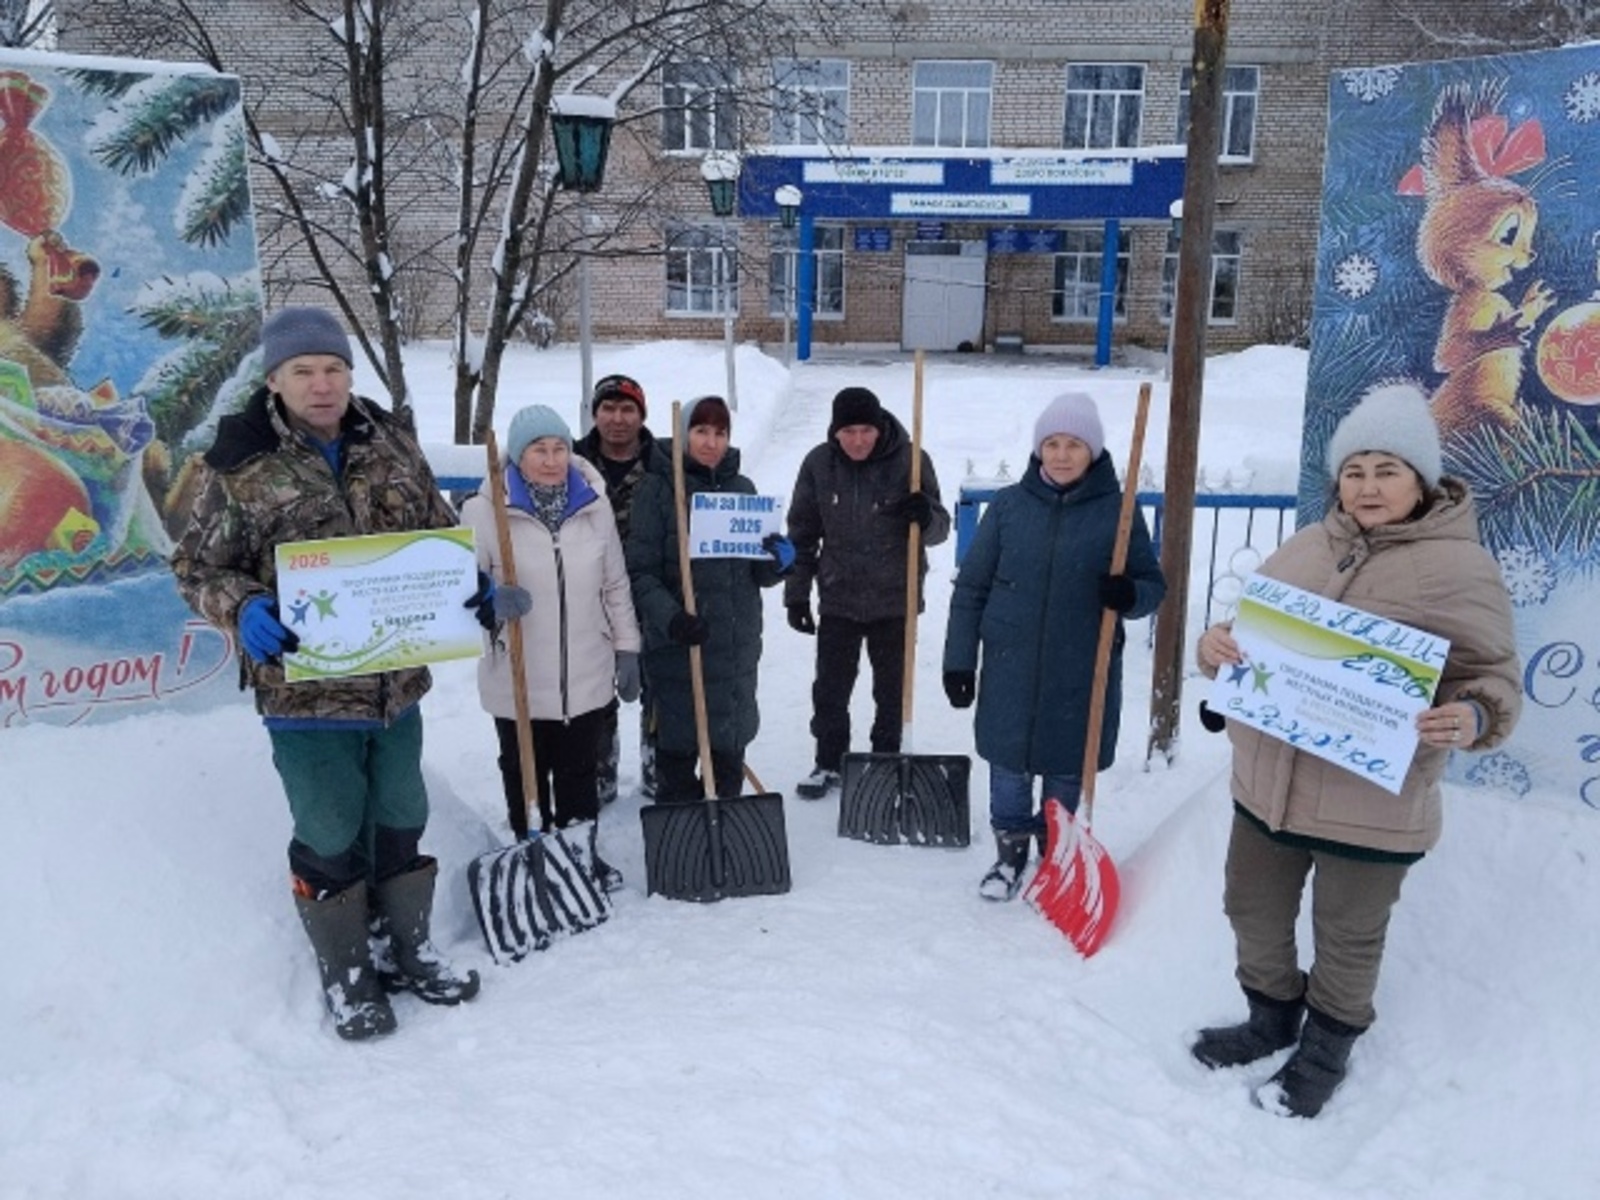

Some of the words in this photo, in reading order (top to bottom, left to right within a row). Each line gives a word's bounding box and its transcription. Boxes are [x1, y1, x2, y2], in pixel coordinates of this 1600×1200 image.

[695, 495, 717, 510] Мы
[719, 497, 735, 510] за
[729, 517, 761, 533] 2026
[289, 552, 331, 570] 2026
[1342, 652, 1433, 698] 2026
